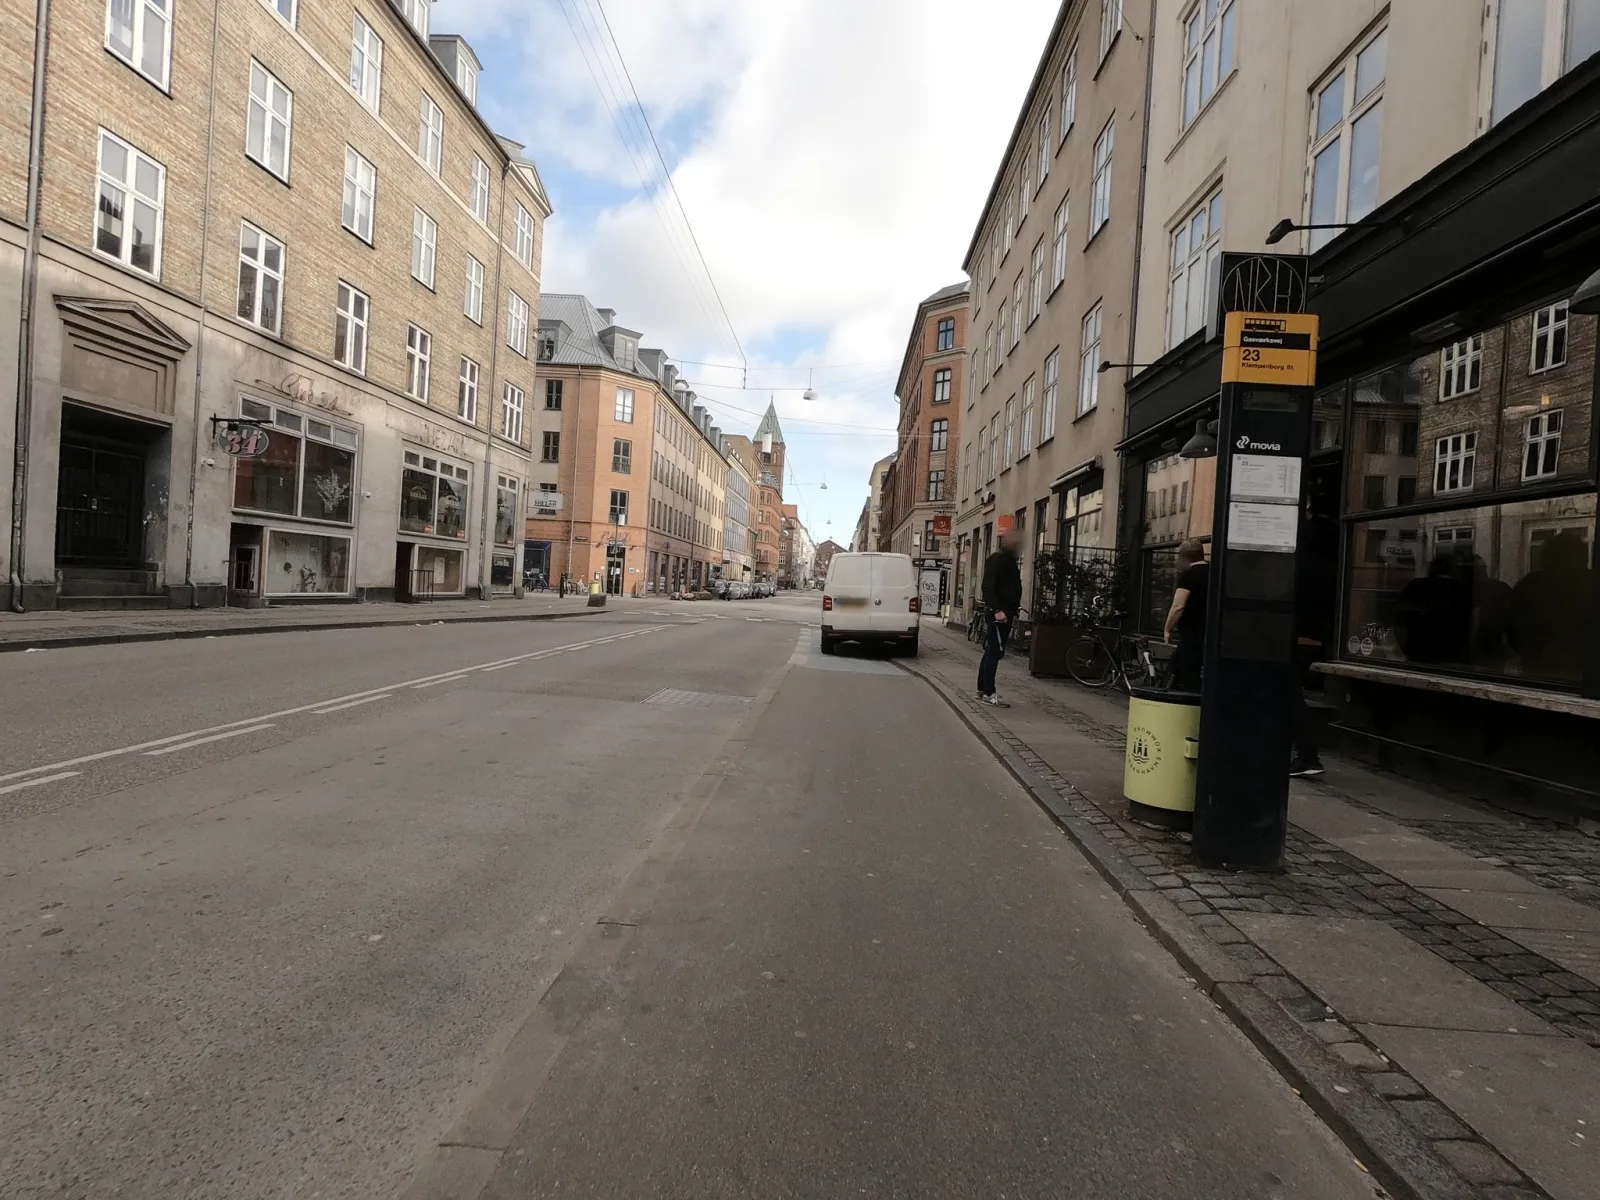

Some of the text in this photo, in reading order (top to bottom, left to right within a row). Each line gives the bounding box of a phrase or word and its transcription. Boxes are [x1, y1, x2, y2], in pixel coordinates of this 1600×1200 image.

[1243, 336, 1283, 345] Gasværksvej
[1242, 349, 1260, 361] 23
[1241, 362, 1285, 371] Klampenborg
[225, 433, 258, 454] 34
[1250, 441, 1281, 450] movia
